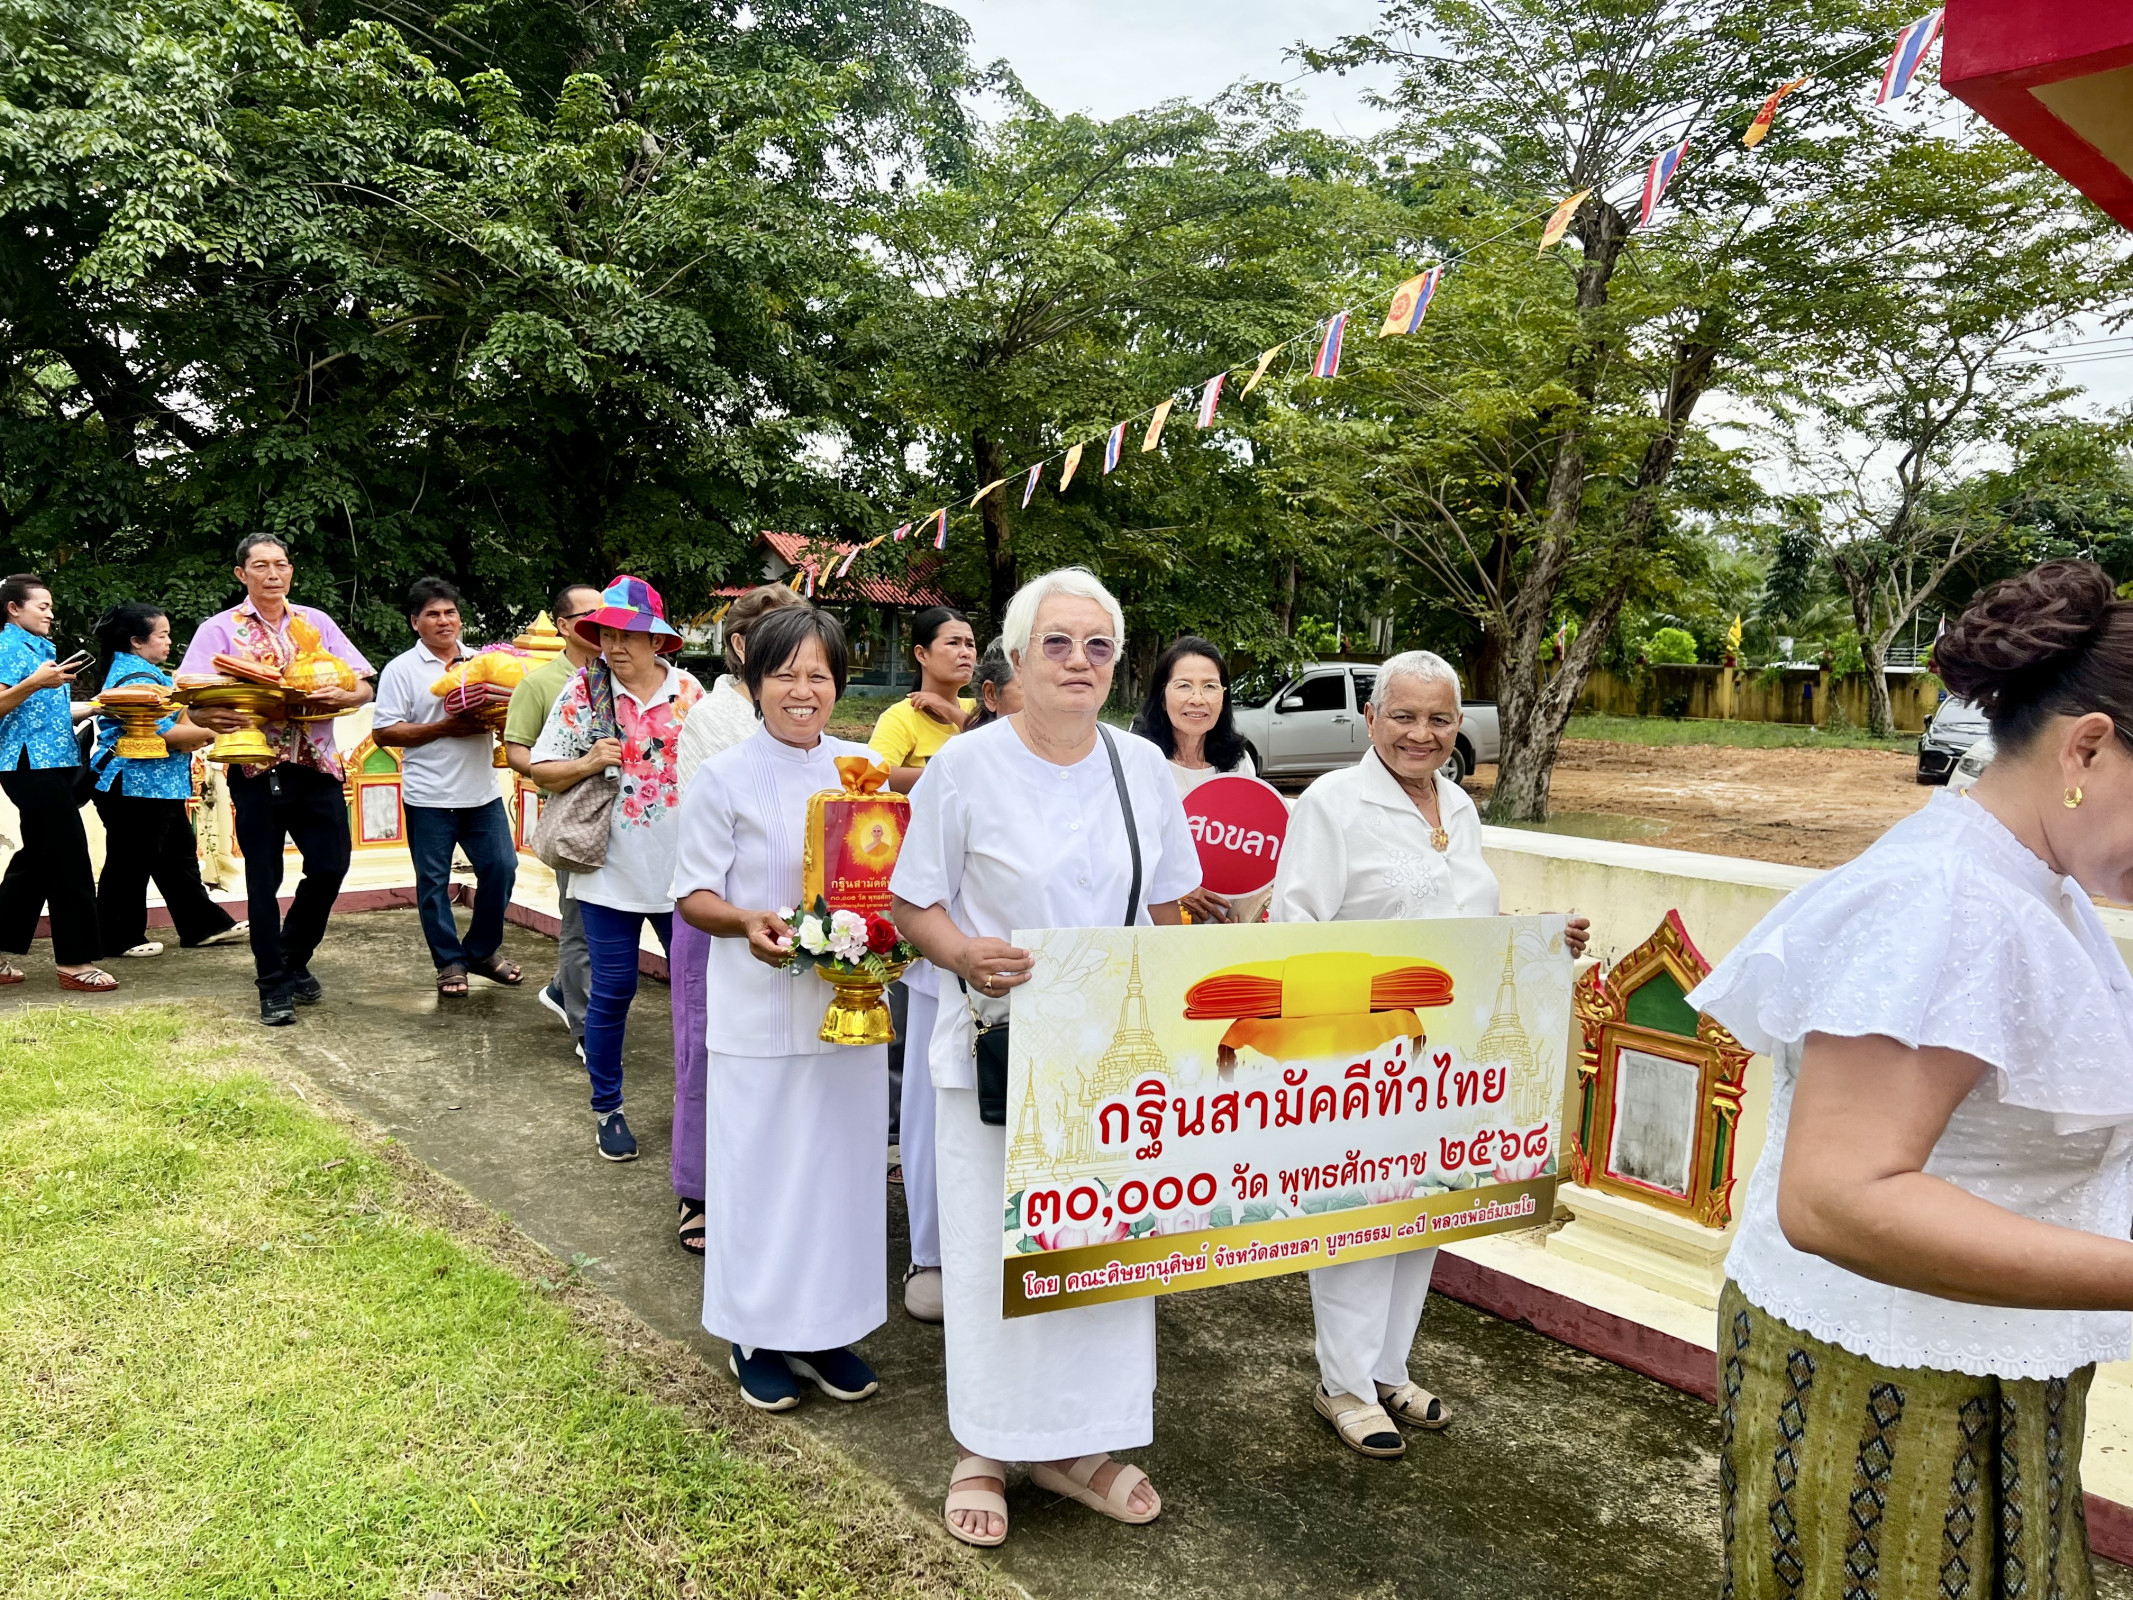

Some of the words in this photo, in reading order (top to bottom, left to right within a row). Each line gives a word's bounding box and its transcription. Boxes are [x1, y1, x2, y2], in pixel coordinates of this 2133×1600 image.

[1187, 815, 1280, 861] สงขลา
[1098, 1043, 1506, 1161] กฐินสามัคคีทั่วไทย
[1027, 1172, 1217, 1227] ๓๐,๐๐๐
[1231, 1162, 1268, 1200] วัด
[1278, 1150, 1427, 1207] พุทธศักราช
[1439, 1122, 1549, 1171] ๒๕๖๘
[1025, 1273, 1058, 1296] โดย
[1067, 1244, 1207, 1290] คณะศิษยานุศิษย์
[1214, 1239, 1319, 1267] จังหวัดสงขลา
